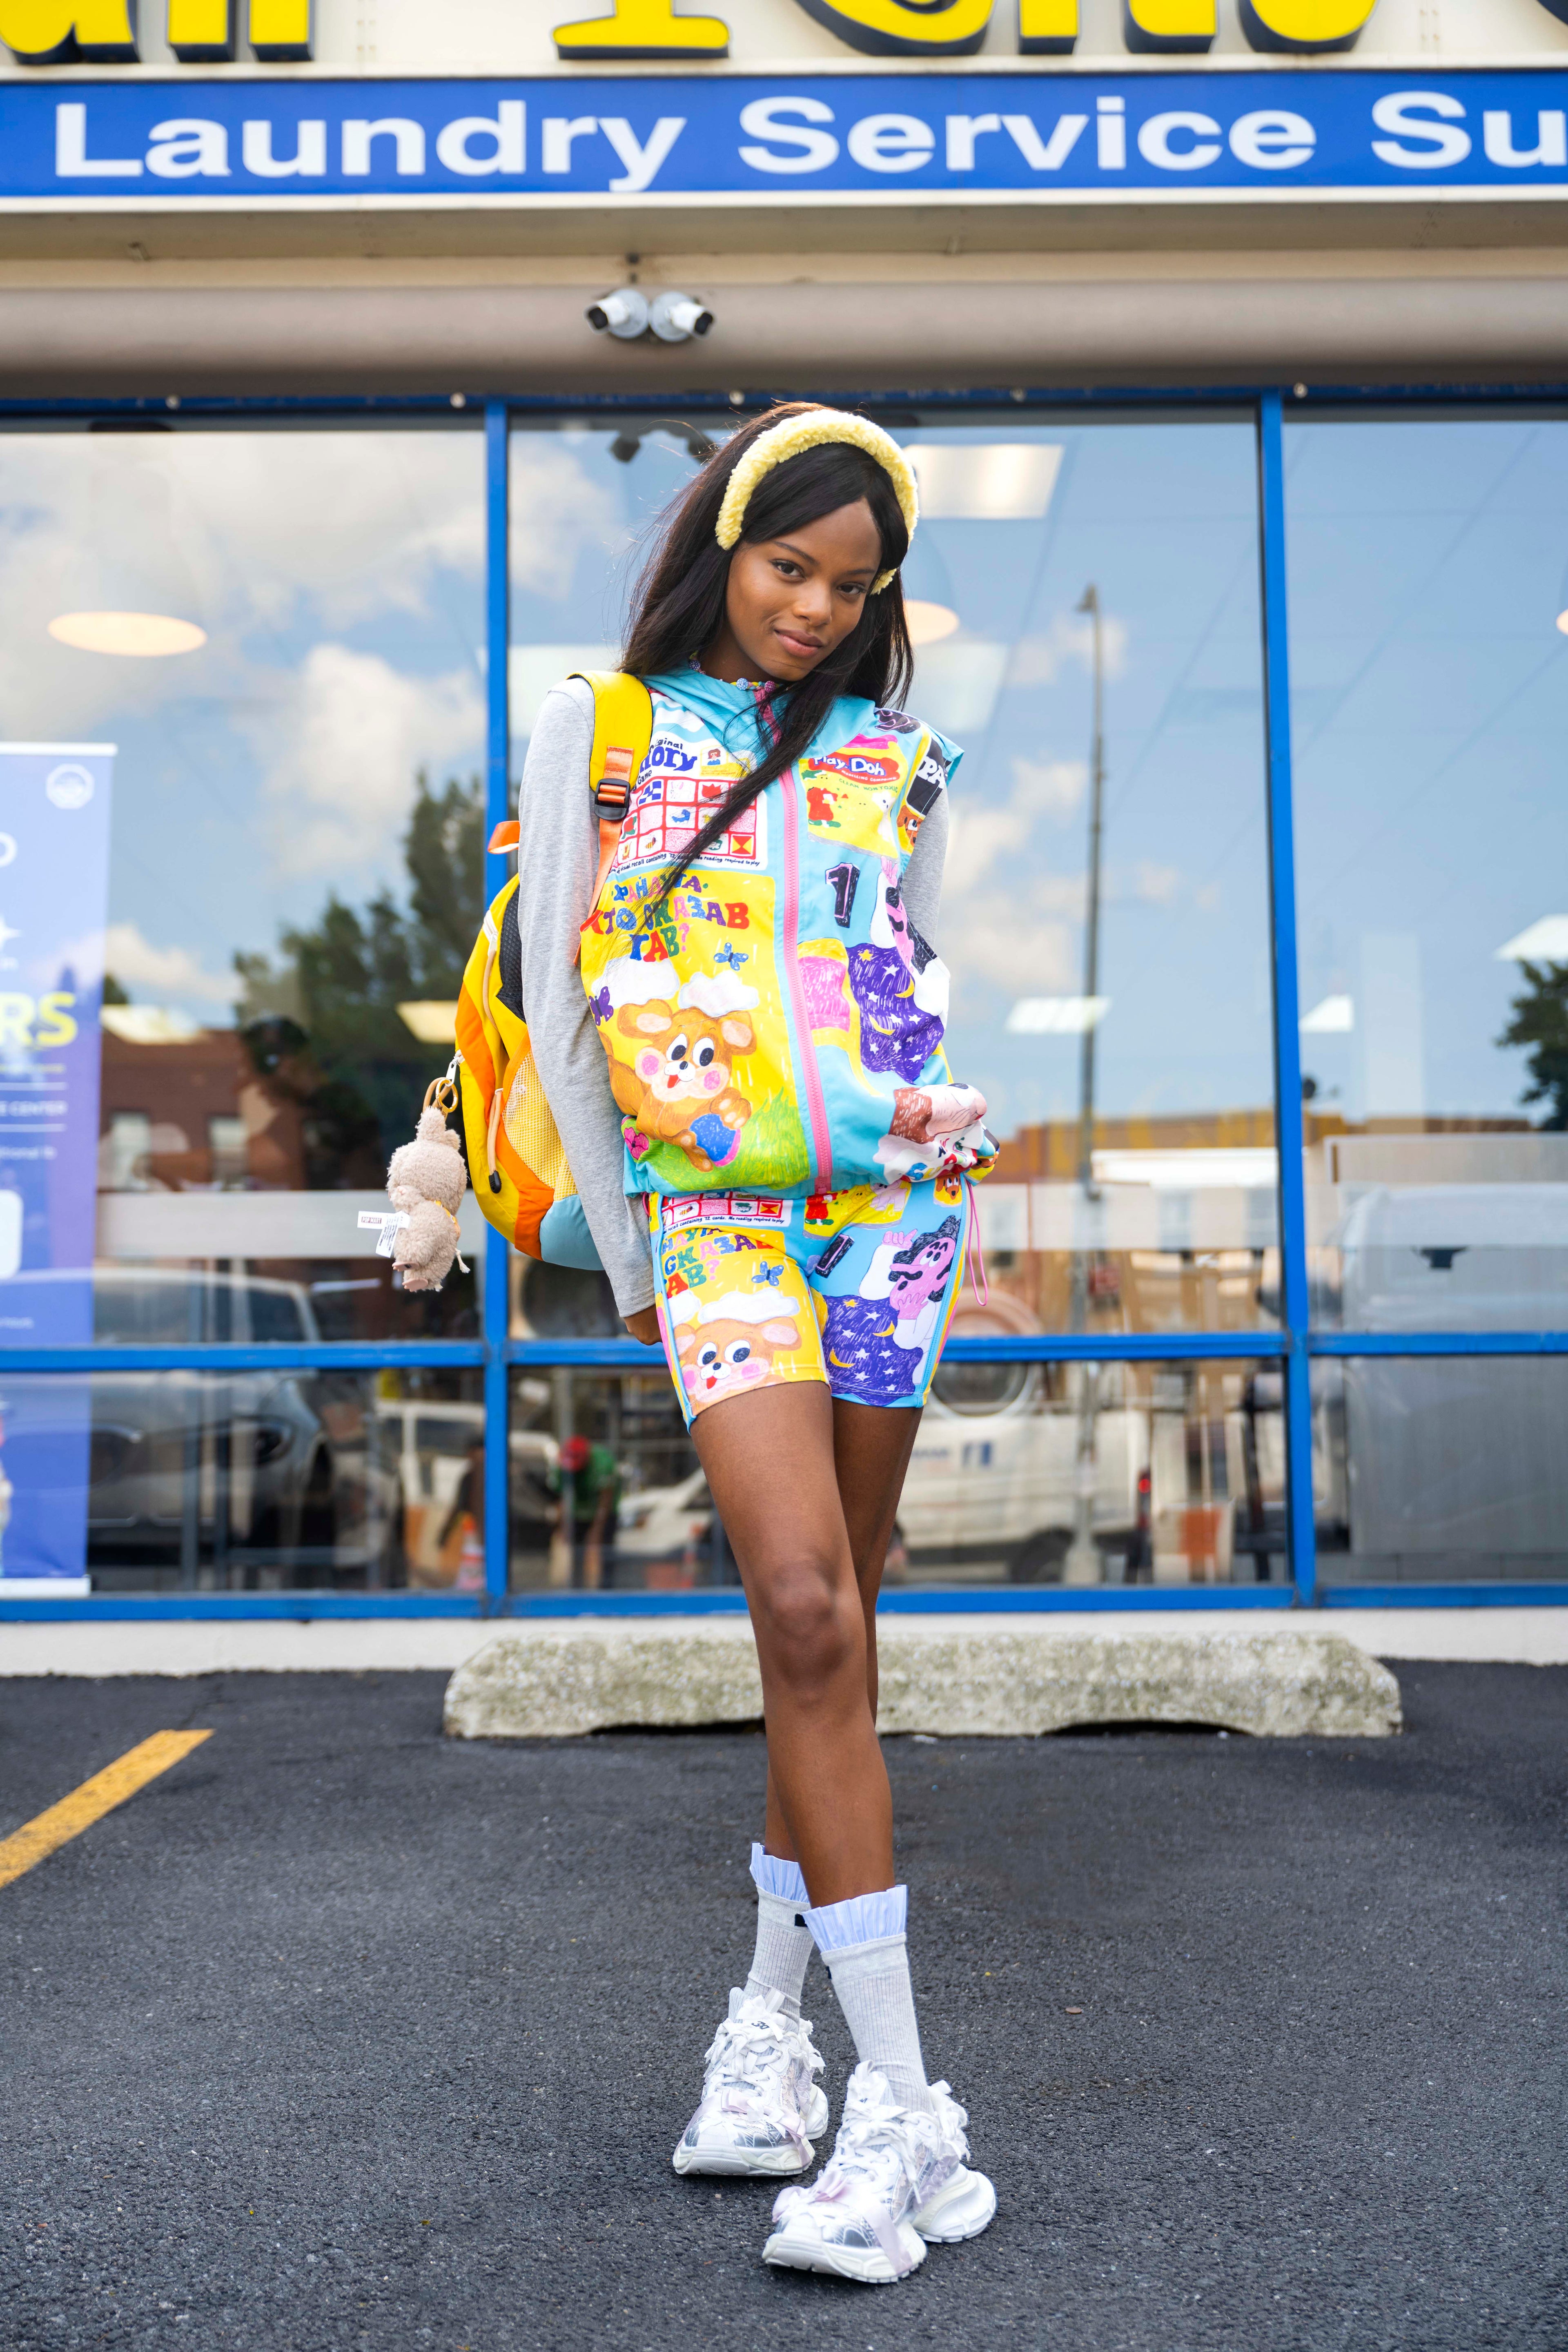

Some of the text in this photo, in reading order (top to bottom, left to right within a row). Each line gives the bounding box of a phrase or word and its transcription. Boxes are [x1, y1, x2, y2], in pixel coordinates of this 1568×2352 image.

[55, 91, 1568, 192] Laundry Service Su
[637, 770, 652, 785] Game
[621, 863, 630, 871] visual
[631, 858, 644, 867] recall
[646, 853, 667, 863] containing
[679, 1217, 702, 1226] containing
